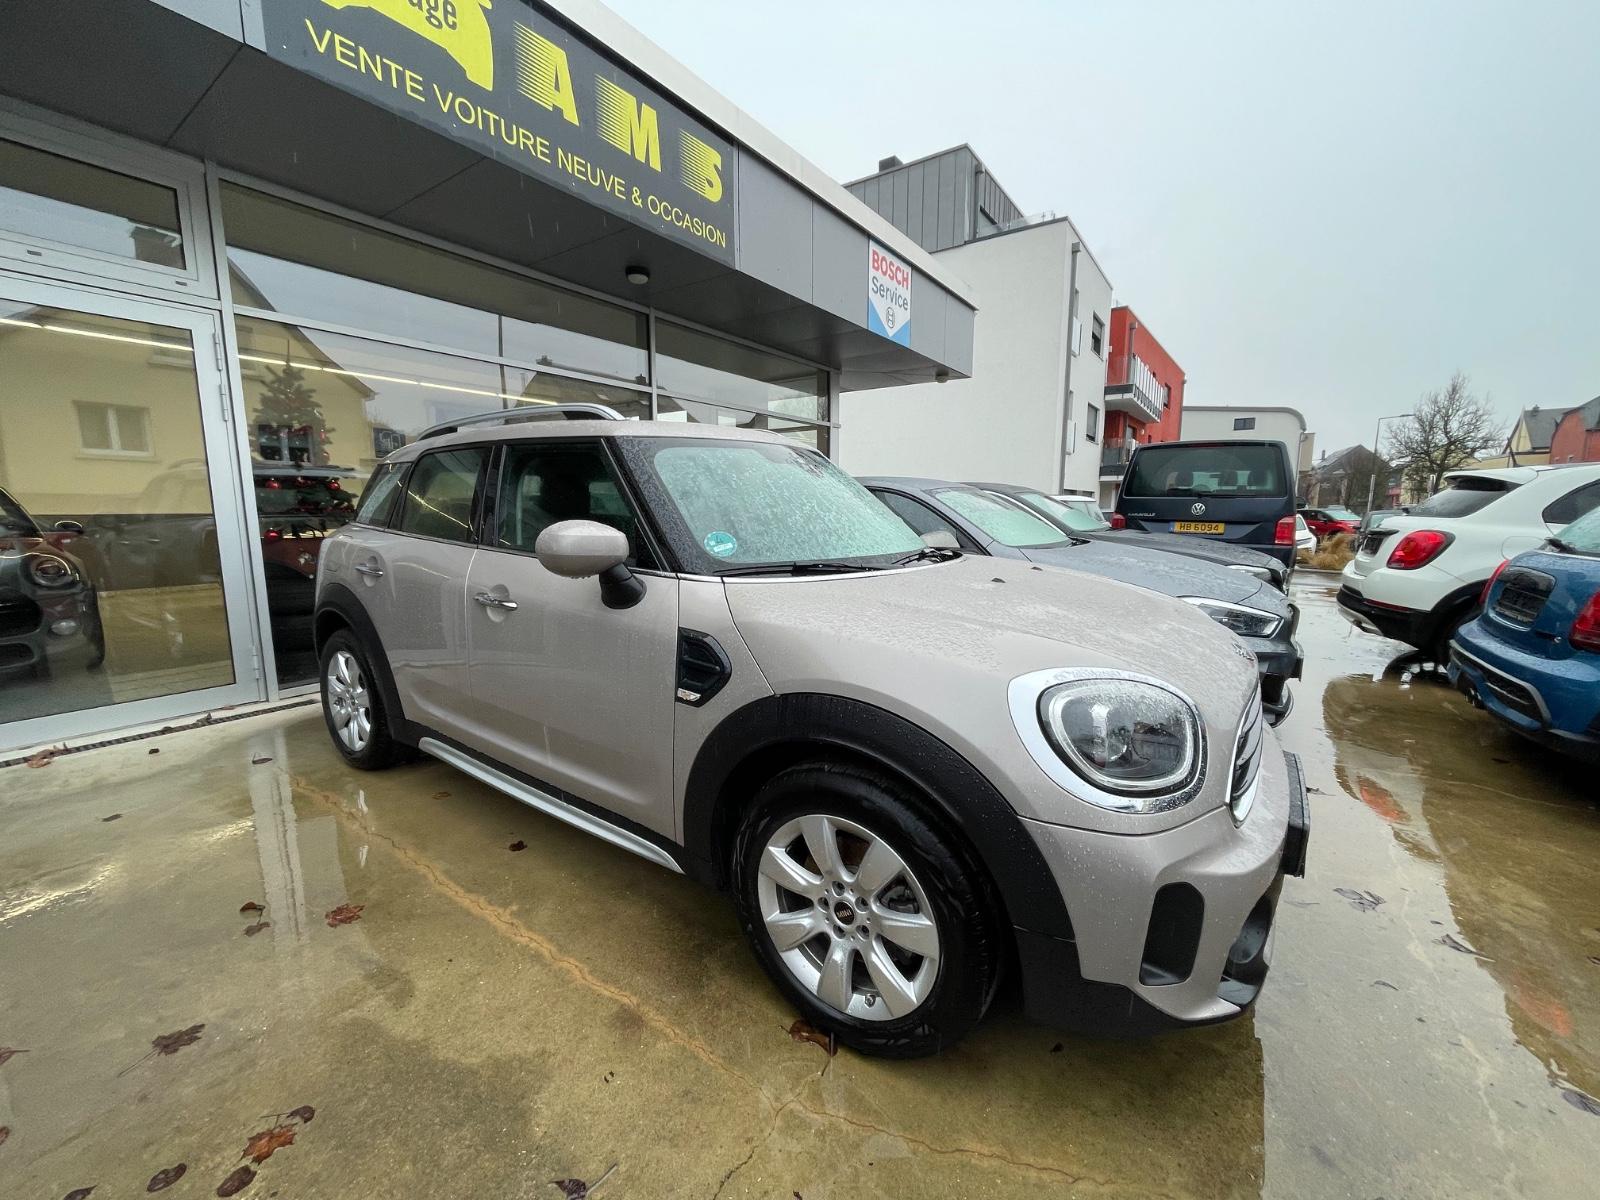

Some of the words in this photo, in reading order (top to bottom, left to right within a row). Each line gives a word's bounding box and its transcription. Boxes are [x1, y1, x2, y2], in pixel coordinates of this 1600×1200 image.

[305, 18, 425, 102] VENTE
[433, 83, 551, 163] VOITURE
[557, 147, 626, 200] NEUVE
[631, 186, 643, 208] &
[647, 195, 726, 248] OCCASION
[871, 248, 909, 290] BOSCH
[871, 276, 909, 311] Service
[1179, 522, 1192, 531] HB
[1193, 523, 1219, 532] 6094
